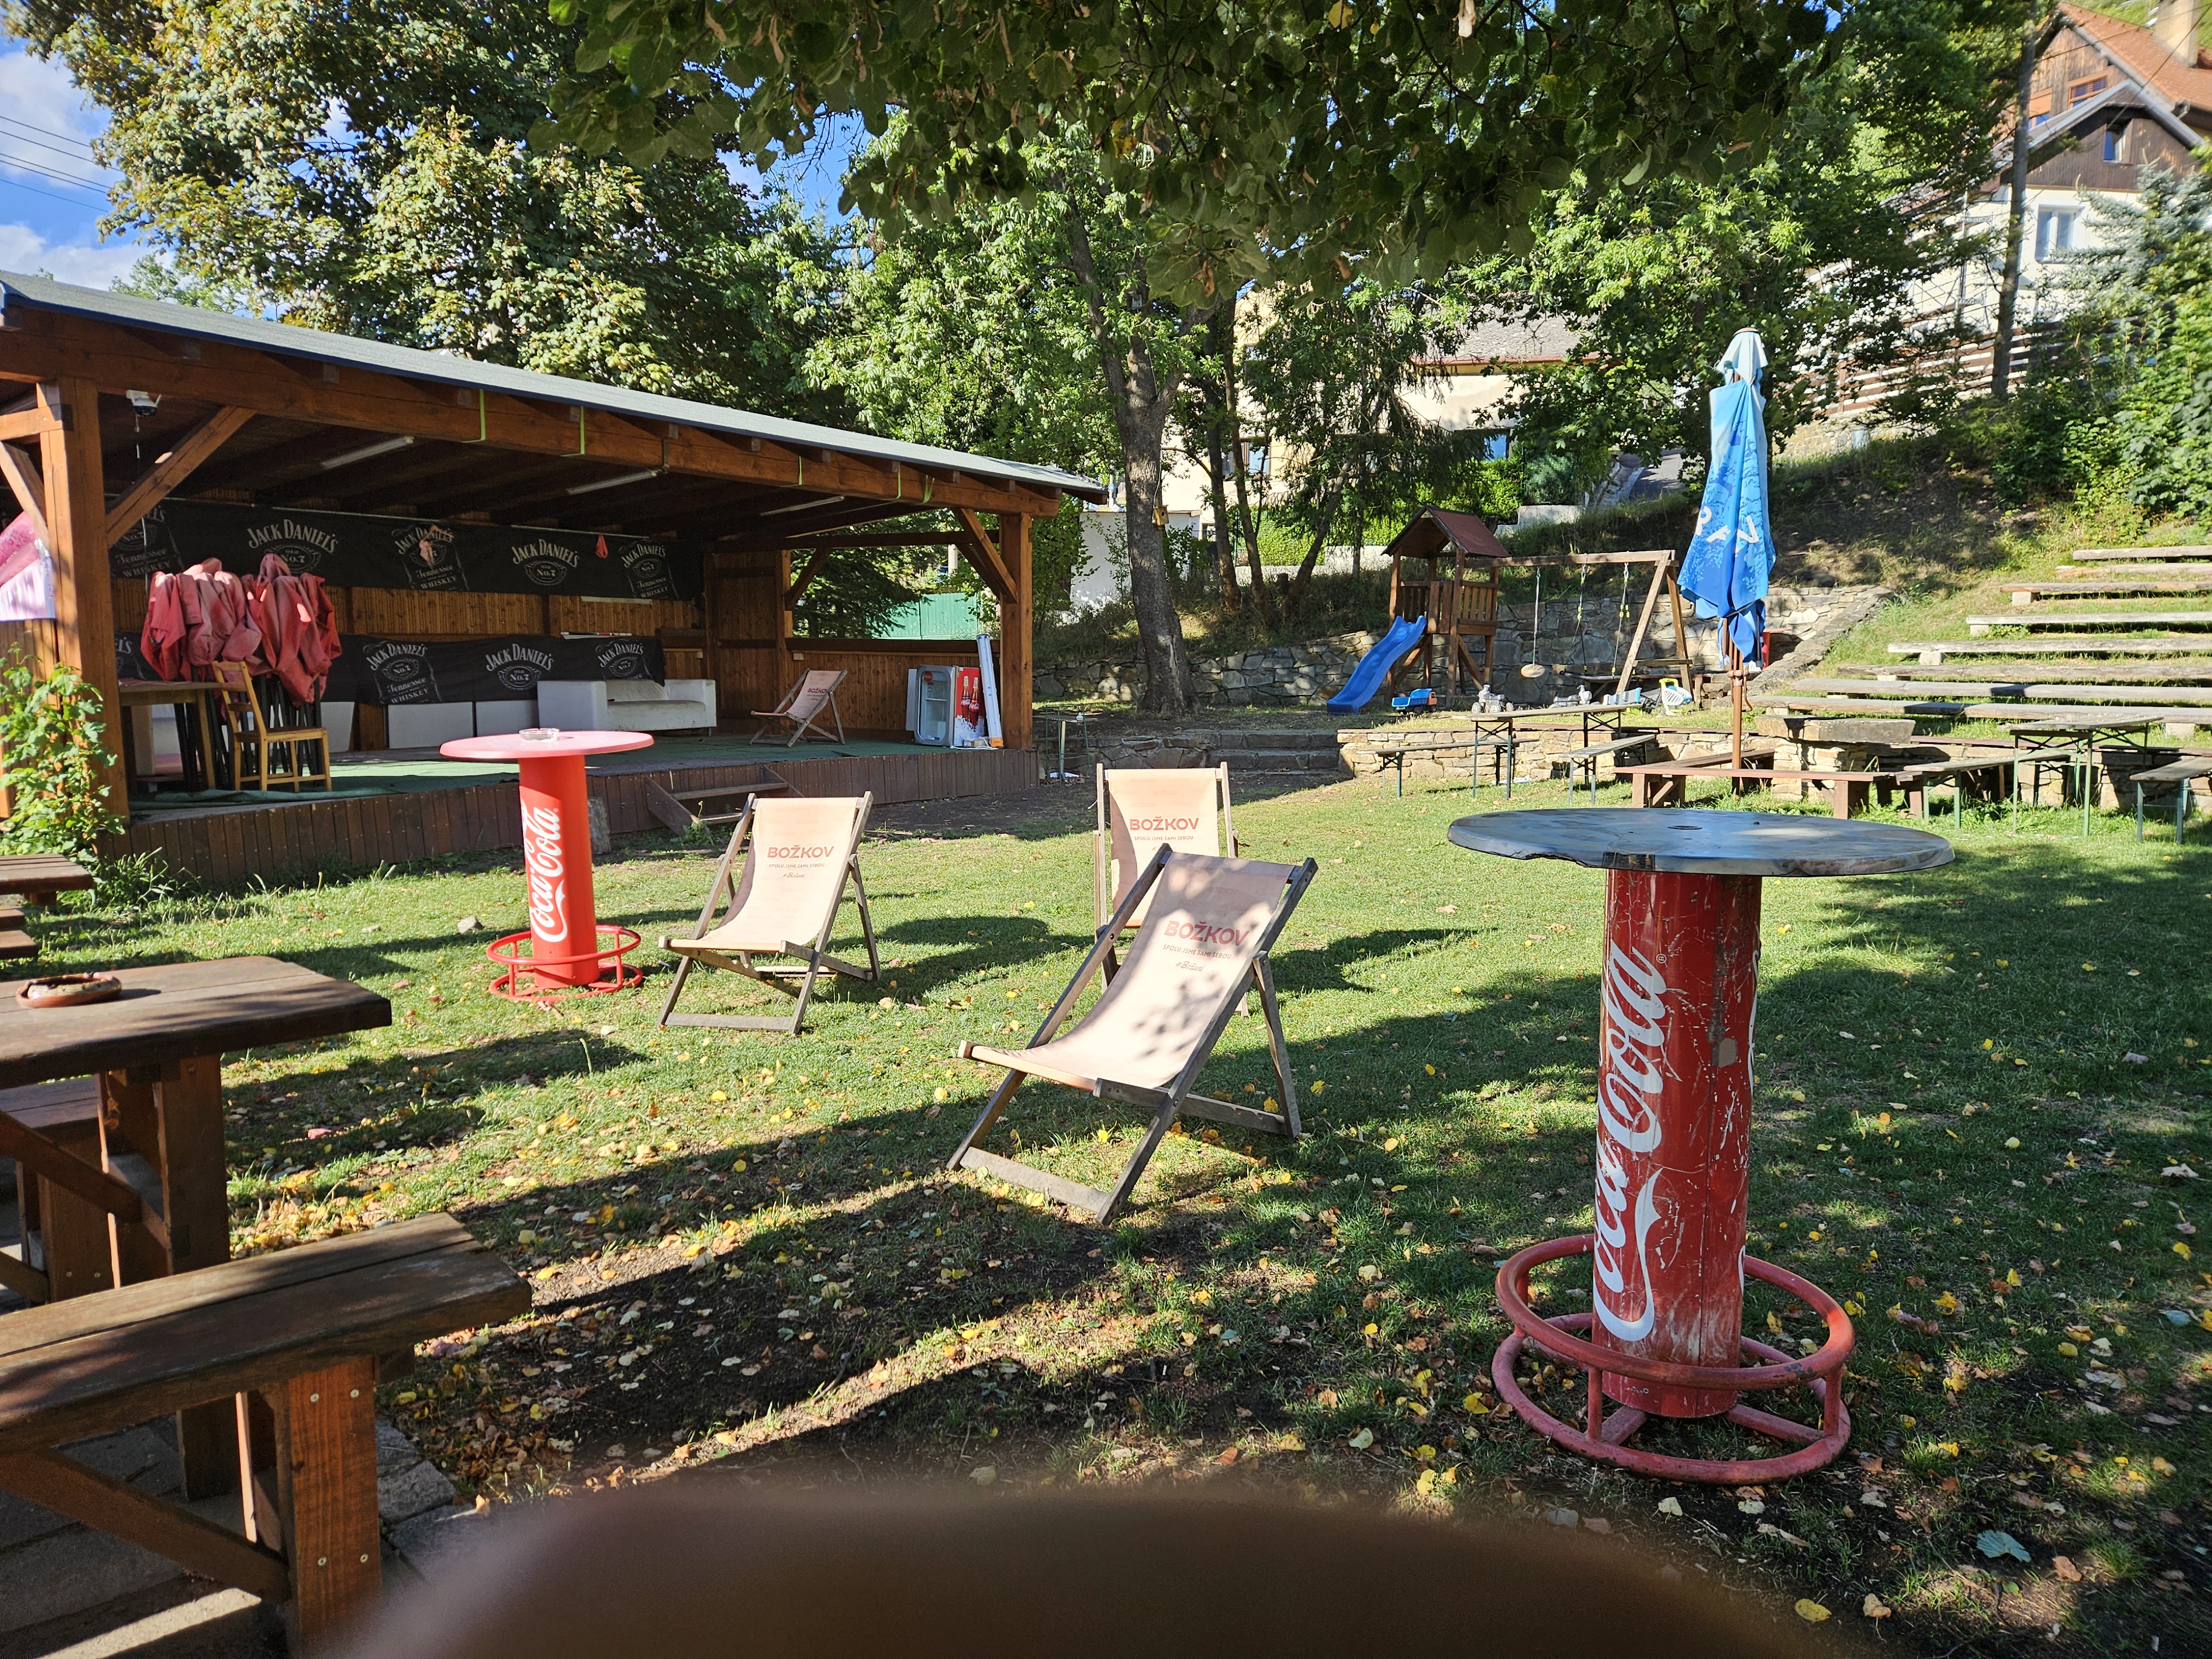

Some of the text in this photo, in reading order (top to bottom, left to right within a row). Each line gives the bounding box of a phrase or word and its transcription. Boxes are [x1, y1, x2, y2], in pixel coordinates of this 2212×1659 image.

[247, 519, 338, 553] JACK DANIEL'S
[394, 533, 418, 555] JACK
[512, 539, 580, 567] JACK DANIEL'S
[621, 549, 640, 568] JACK
[421, 576, 457, 589] WHISKEY
[366, 644, 427, 671] JACK DANIEL'S
[485, 644, 554, 671] JACK DANIEL'S
[598, 643, 644, 667] JACK DANIEL'S
[387, 677, 426, 693] Tennessee
[391, 687, 428, 703] WHISKEY
[1130, 816, 1199, 830] BOŽKOV
[767, 844, 834, 858] BOŽKOV
[1164, 921, 1250, 946] BOŽKOV
[1162, 944, 1181, 952] SPOLU
[1593, 940, 1667, 1342] CocaCola
